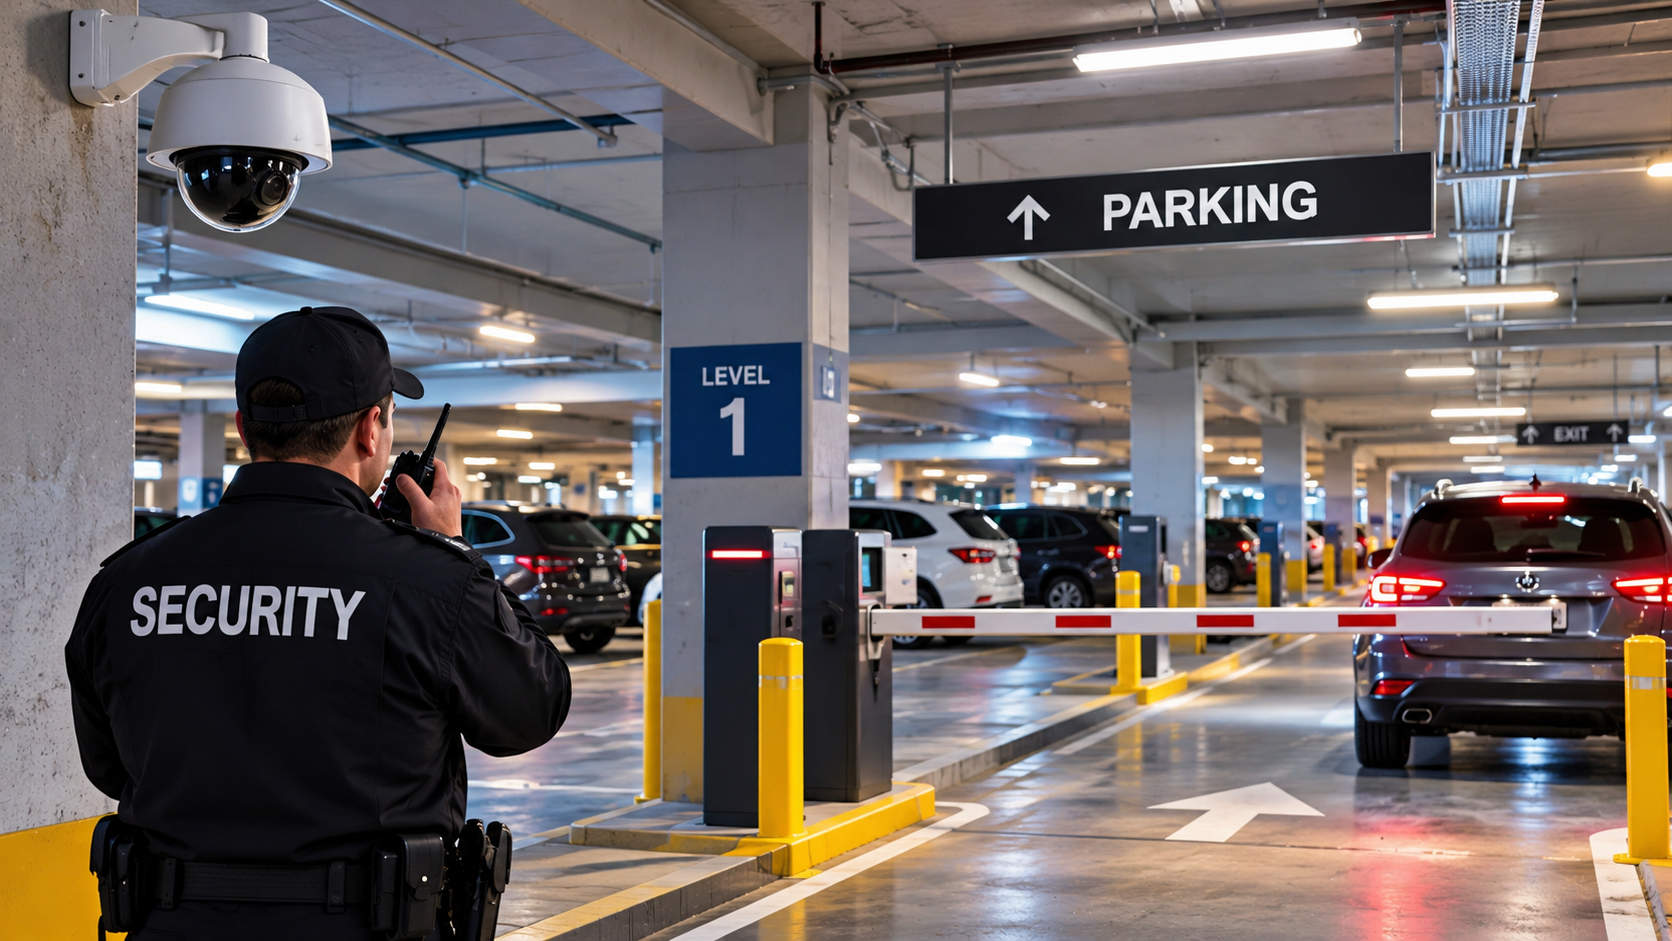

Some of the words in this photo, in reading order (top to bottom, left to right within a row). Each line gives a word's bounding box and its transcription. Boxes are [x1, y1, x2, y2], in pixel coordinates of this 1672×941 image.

[1103, 181, 1318, 232] PARKING
[702, 365, 771, 386] LEVEL
[719, 397, 745, 456] 1
[1554, 426, 1590, 442] EXIT
[130, 584, 367, 641] SECURITY
